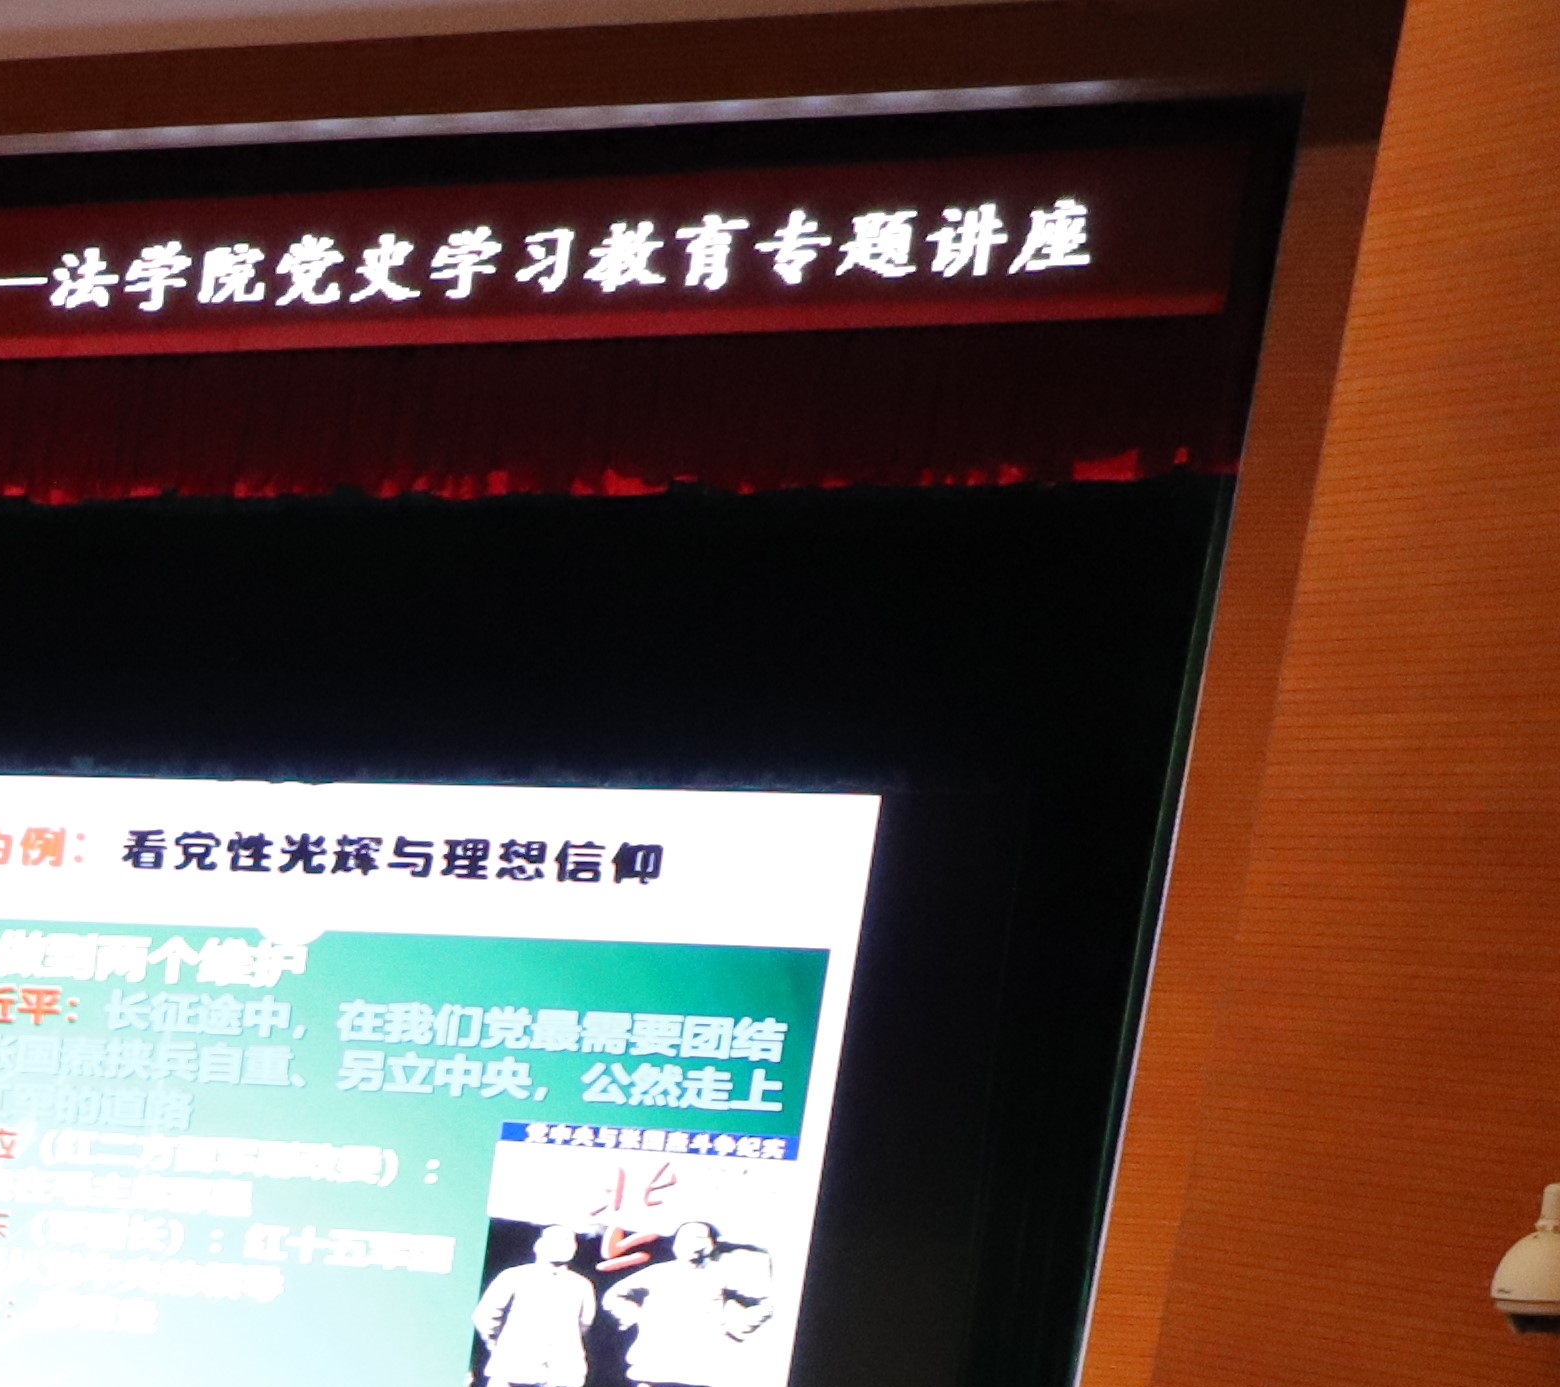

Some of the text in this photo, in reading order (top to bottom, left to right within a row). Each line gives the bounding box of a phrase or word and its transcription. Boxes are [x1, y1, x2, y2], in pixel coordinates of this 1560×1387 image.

[121, 829, 665, 885] 看党性光辉与理想信仰
